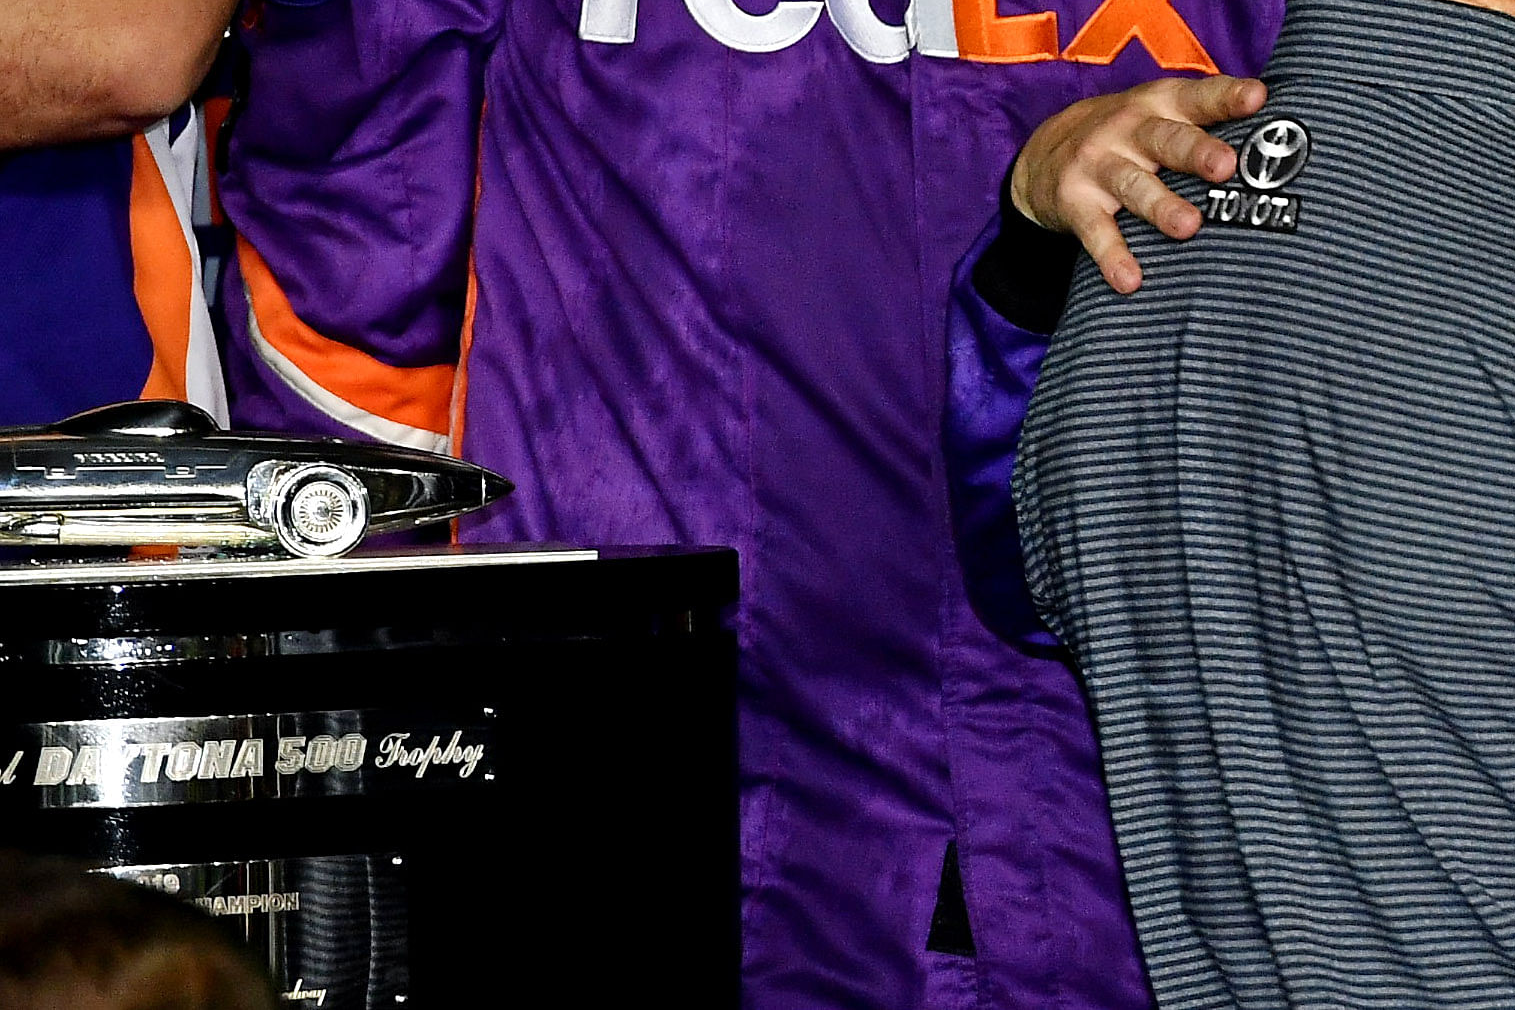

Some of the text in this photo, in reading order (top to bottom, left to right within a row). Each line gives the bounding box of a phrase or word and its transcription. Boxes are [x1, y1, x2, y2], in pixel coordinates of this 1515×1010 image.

[1208, 189, 1297, 227] TOYOTA
[34, 738, 264, 786] DATONA
[275, 733, 367, 775] 500
[375, 730, 484, 780] Trophy
